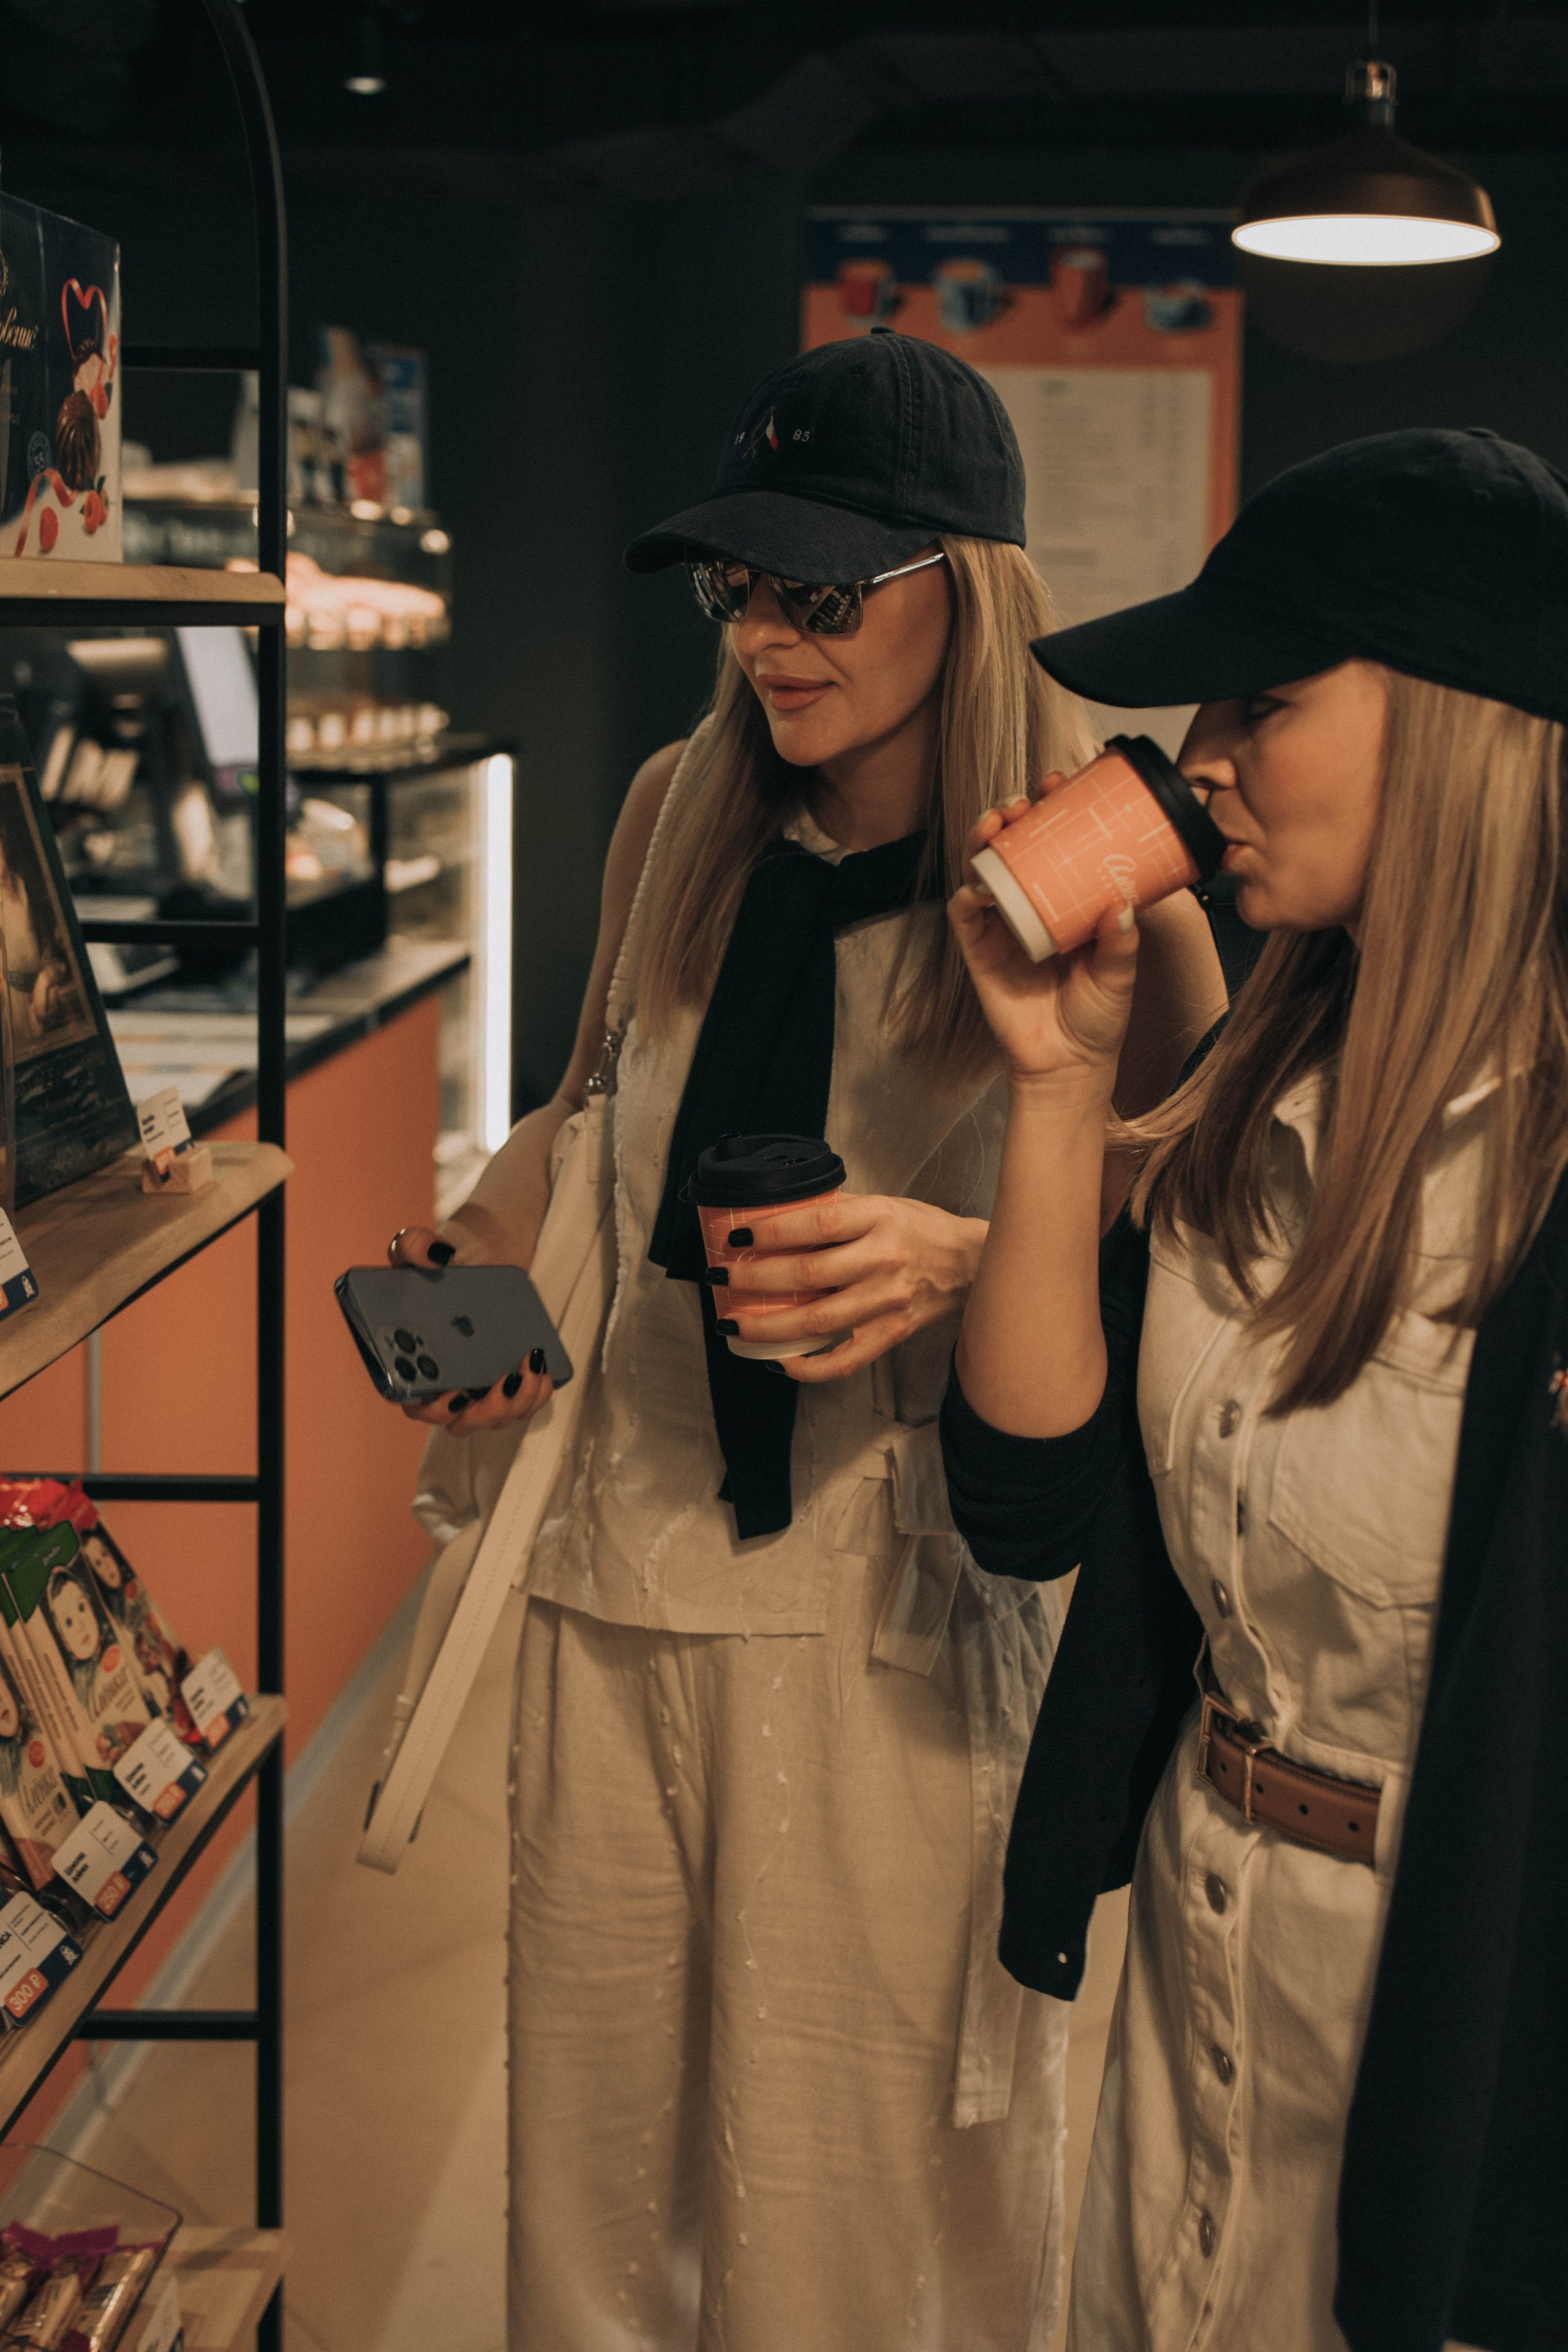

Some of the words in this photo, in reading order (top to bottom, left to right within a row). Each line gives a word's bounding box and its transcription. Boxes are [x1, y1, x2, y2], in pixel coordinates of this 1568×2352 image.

[735, 431, 745, 445] 19
[793, 429, 810, 442] 85
[9, 1983, 34, 2011] 300
